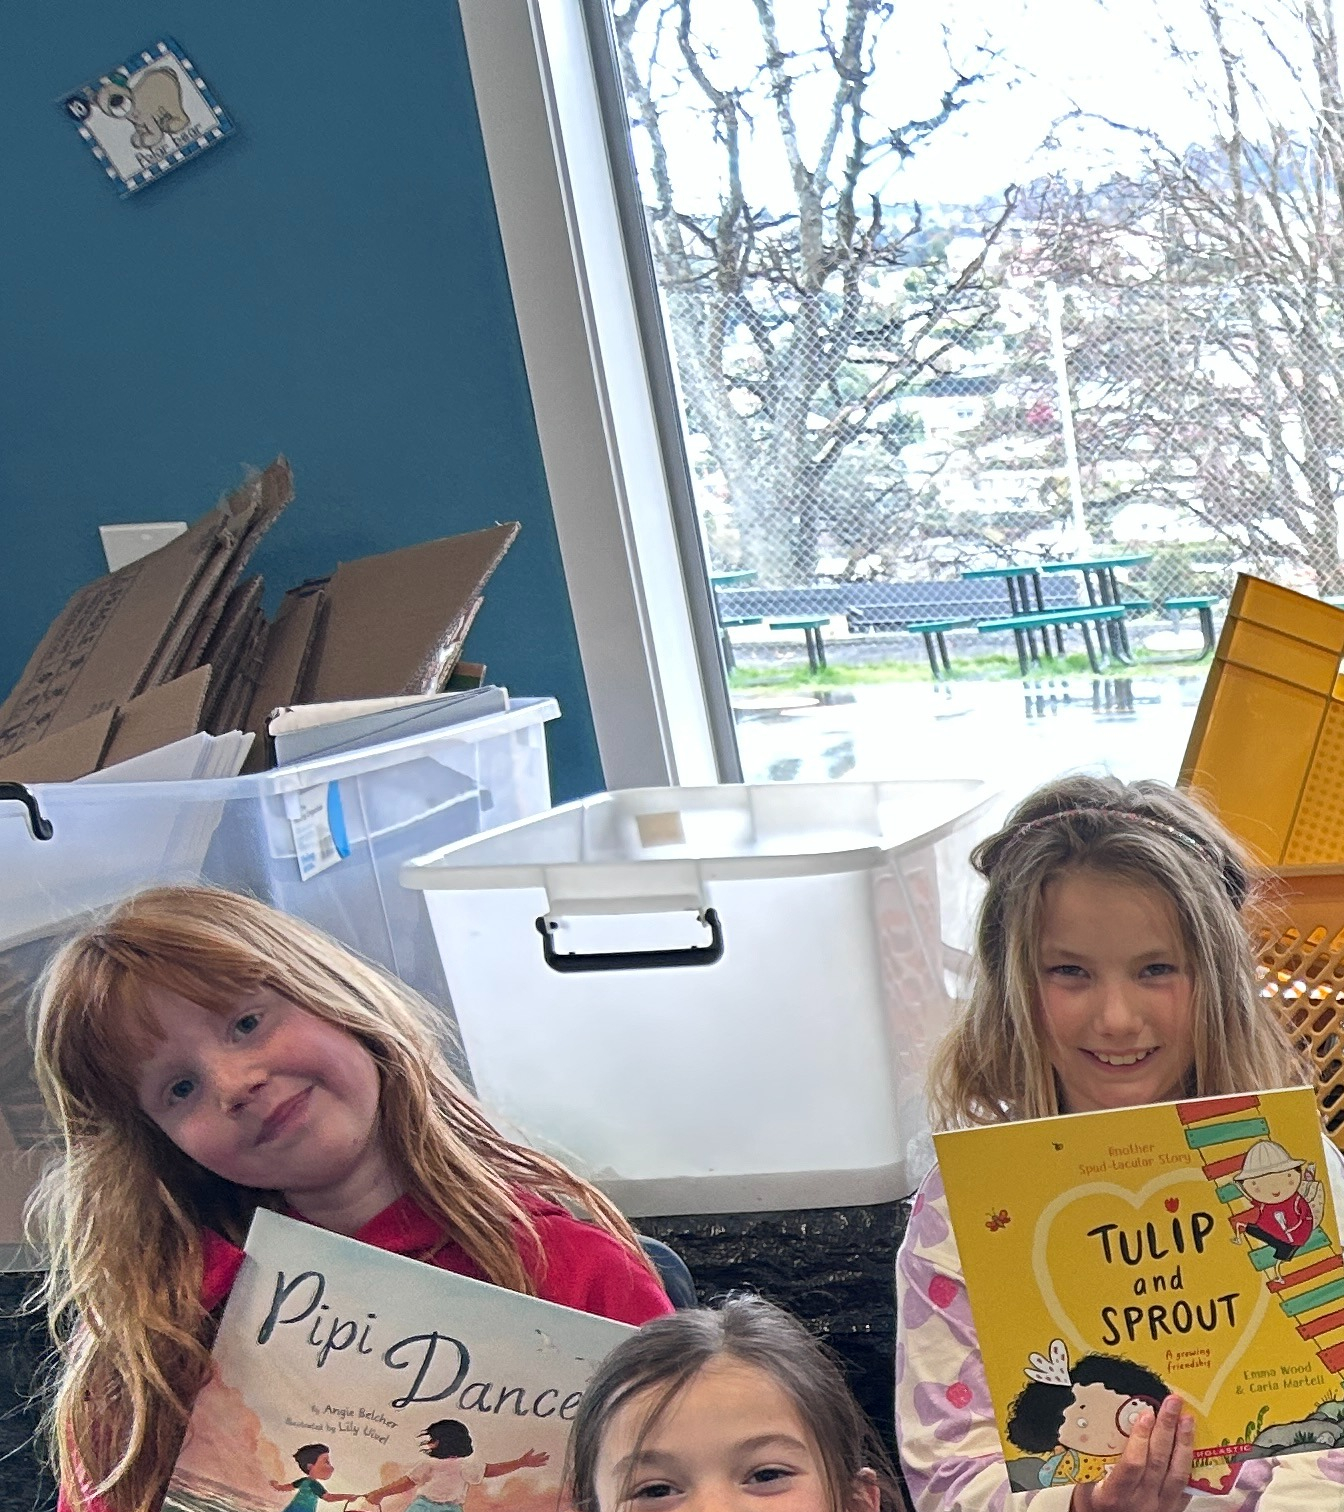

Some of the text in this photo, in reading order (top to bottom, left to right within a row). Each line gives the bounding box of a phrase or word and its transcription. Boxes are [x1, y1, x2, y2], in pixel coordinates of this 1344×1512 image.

[1108, 1143, 1155, 1156] Another
[1158, 1153, 1191, 1164] Story
[1133, 1266, 1184, 1296] and
[1101, 1293, 1240, 1347] SPROUT
[257, 1269, 584, 1421] Pipi Dance
[1165, 1348, 1210, 1360] A growing
[1167, 1359, 1211, 1373] friendship
[1243, 1361, 1312, 1380] Emma Wood
[1235, 1374, 1325, 1395] & Carla Martell
[323, 1404, 354, 1419] Angie
[358, 1407, 398, 1429] Belcher
[325, 1423, 336, 1433] by
[338, 1420, 360, 1436] Lily
[1196, 1445, 1250, 1457] HOLASTIC
